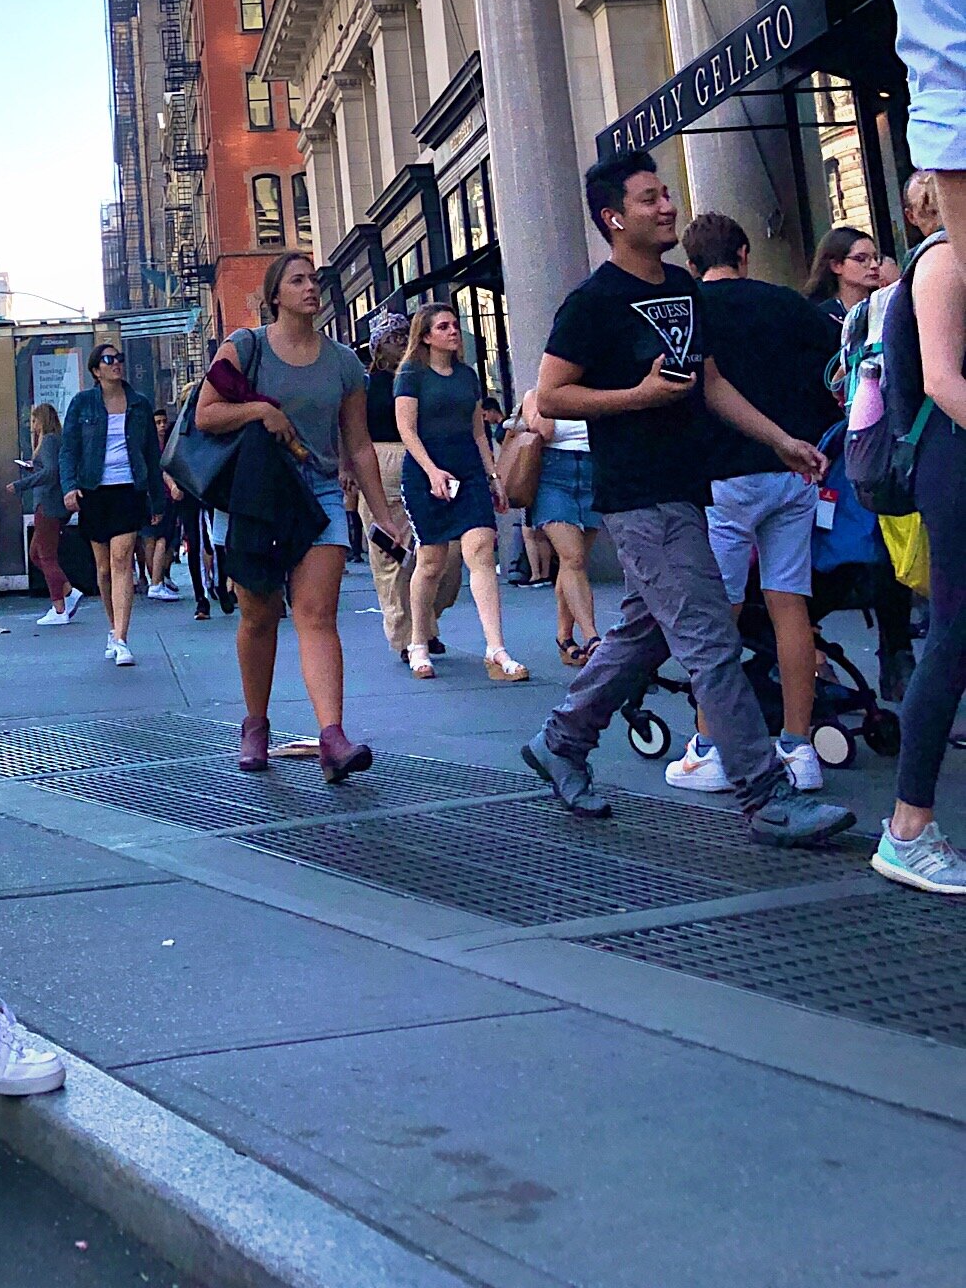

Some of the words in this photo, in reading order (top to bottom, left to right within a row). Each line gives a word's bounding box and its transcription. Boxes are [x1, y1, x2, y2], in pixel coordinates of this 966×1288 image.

[612, 82, 683, 154] EATALY
[694, 4, 794, 107] GELATO
[647, 303, 690, 320] GUESS
